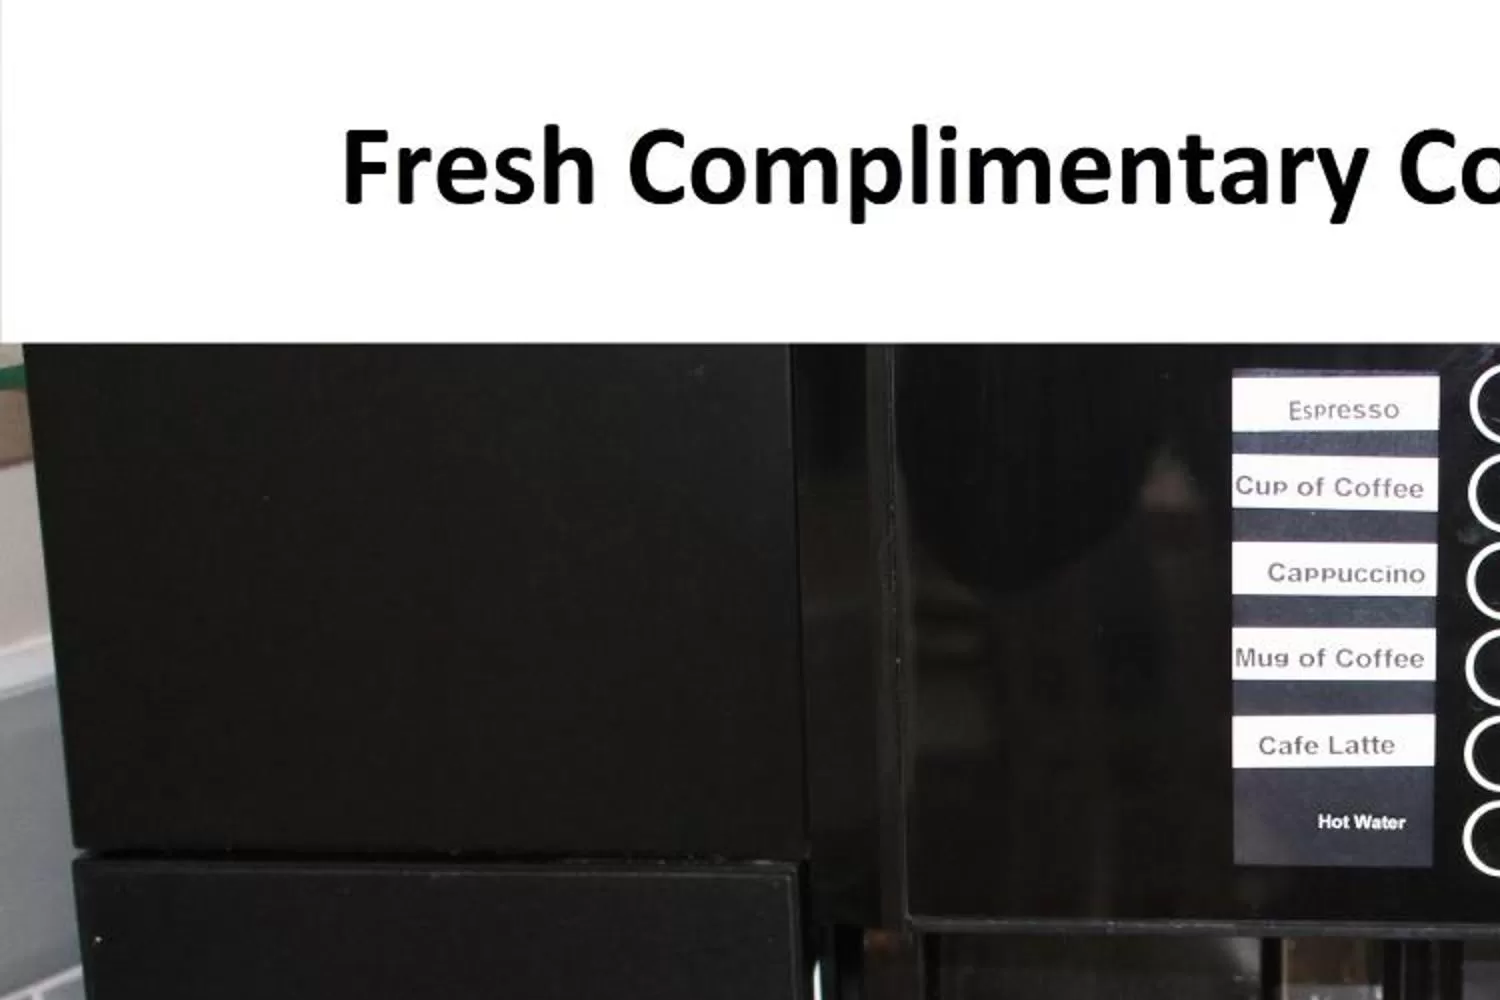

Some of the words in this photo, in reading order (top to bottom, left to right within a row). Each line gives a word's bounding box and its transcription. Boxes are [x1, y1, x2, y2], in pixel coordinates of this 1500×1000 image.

[1289, 400, 1400, 421] Espresso
[1235, 475, 1289, 496] Cup
[1297, 476, 1325, 497] of
[1334, 476, 1424, 499] Coffee
[1267, 562, 1426, 584] Cappuccino
[1235, 647, 1289, 668] Mug
[1298, 647, 1326, 668] of
[1335, 647, 1425, 669] Coffee
[1258, 735, 1319, 756] Cafe
[1329, 735, 1396, 755] Latte
[1317, 813, 1351, 830] Hot
[1353, 813, 1407, 831] Water
